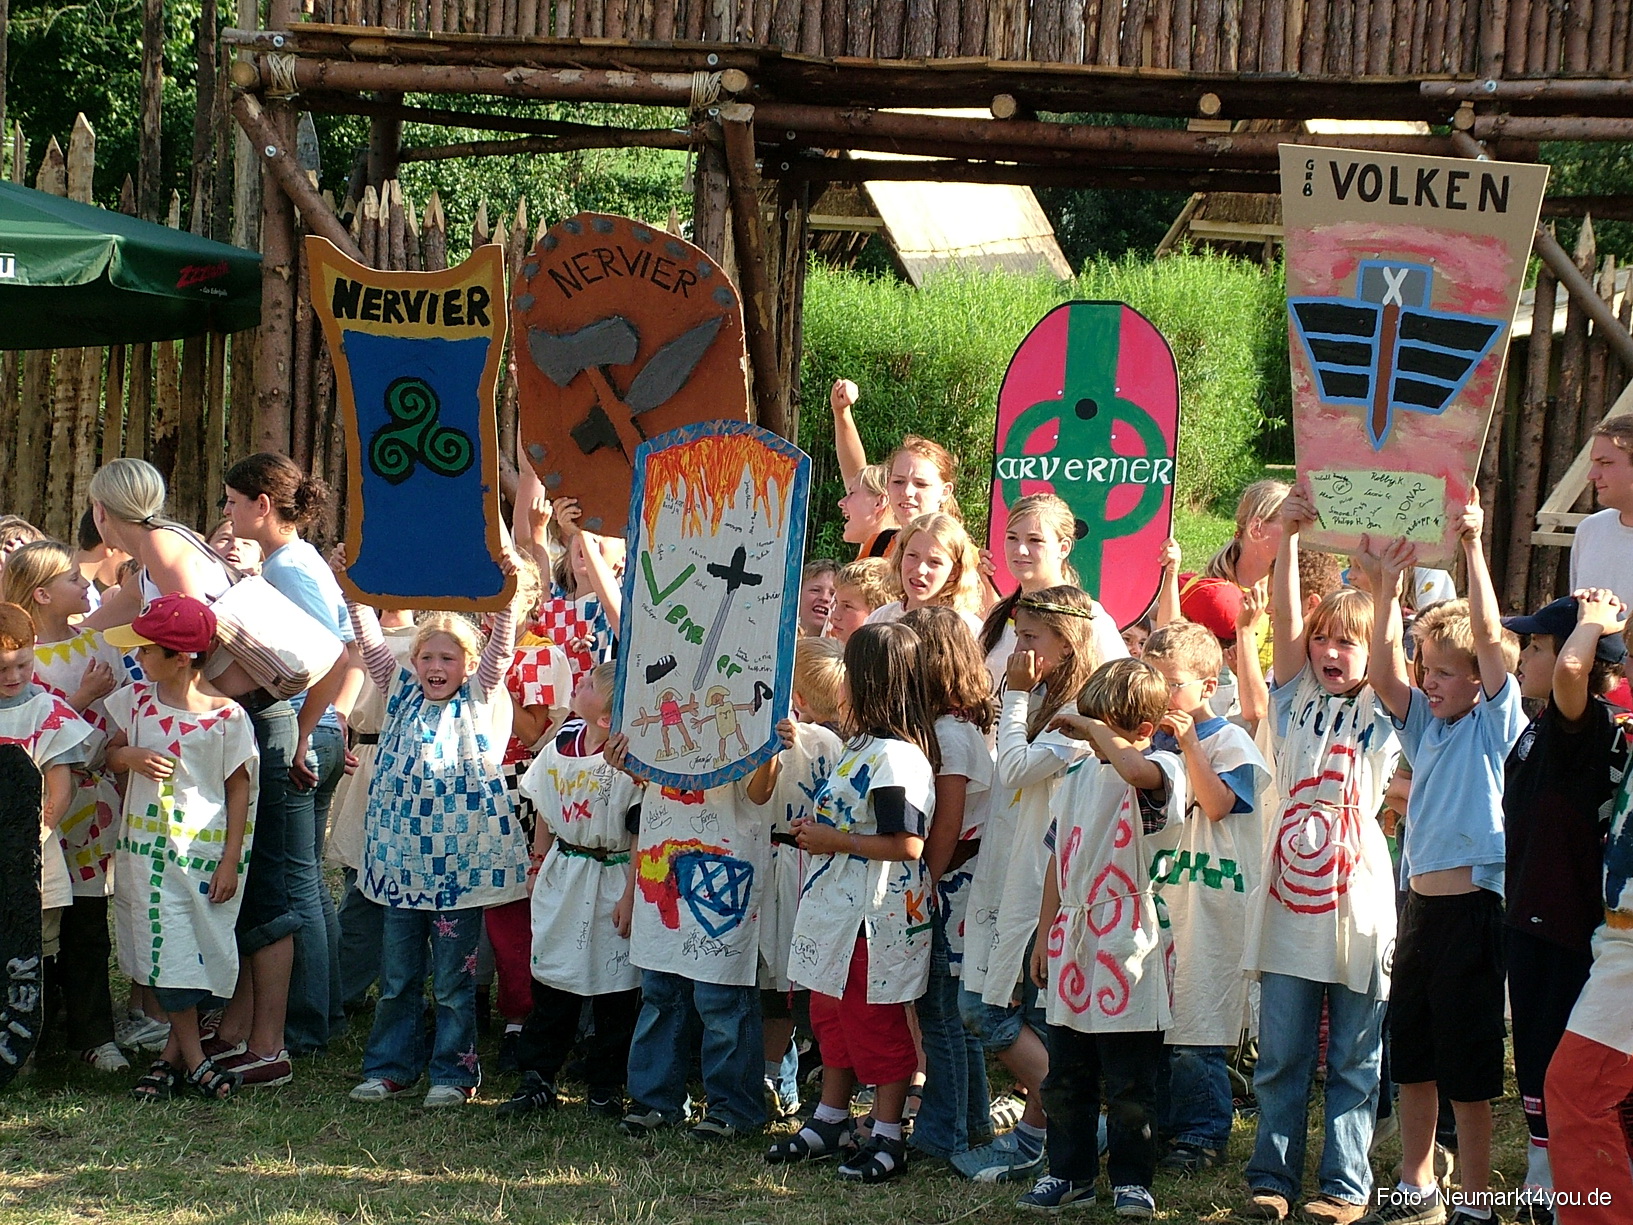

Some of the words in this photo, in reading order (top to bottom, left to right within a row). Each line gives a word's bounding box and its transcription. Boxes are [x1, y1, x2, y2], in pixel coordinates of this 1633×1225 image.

[1329, 160, 1511, 214] VOLKEN
[547, 245, 699, 299] NERVIER
[331, 277, 491, 328] NERVIER
